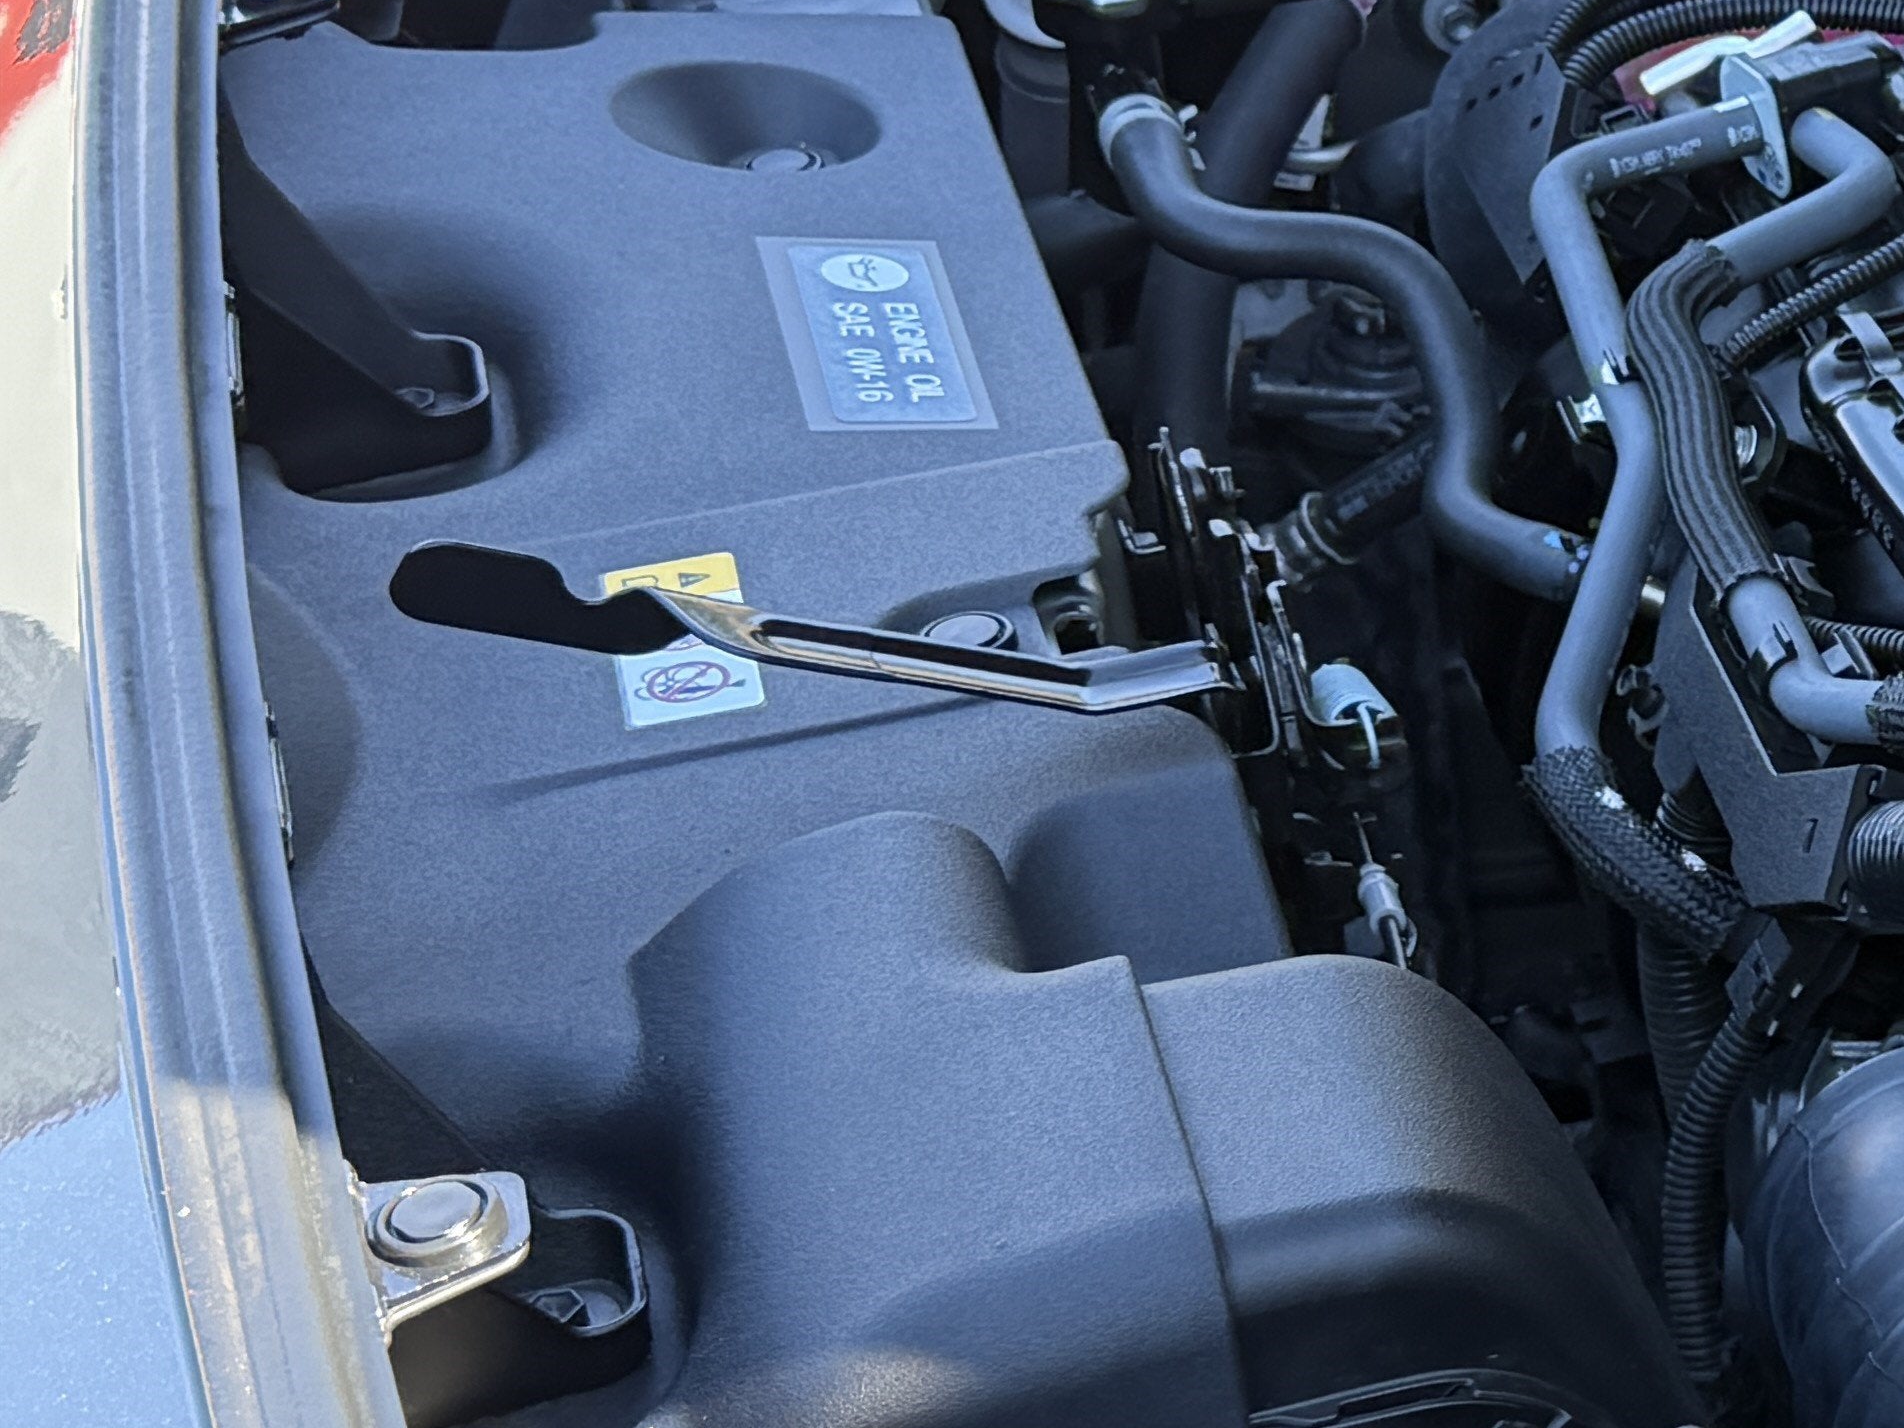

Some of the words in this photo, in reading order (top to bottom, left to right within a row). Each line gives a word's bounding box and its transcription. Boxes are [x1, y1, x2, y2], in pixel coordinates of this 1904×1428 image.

[832, 302, 875, 337] SAE
[882, 302, 934, 364] ENGINE
[905, 374, 945, 403] OIL
